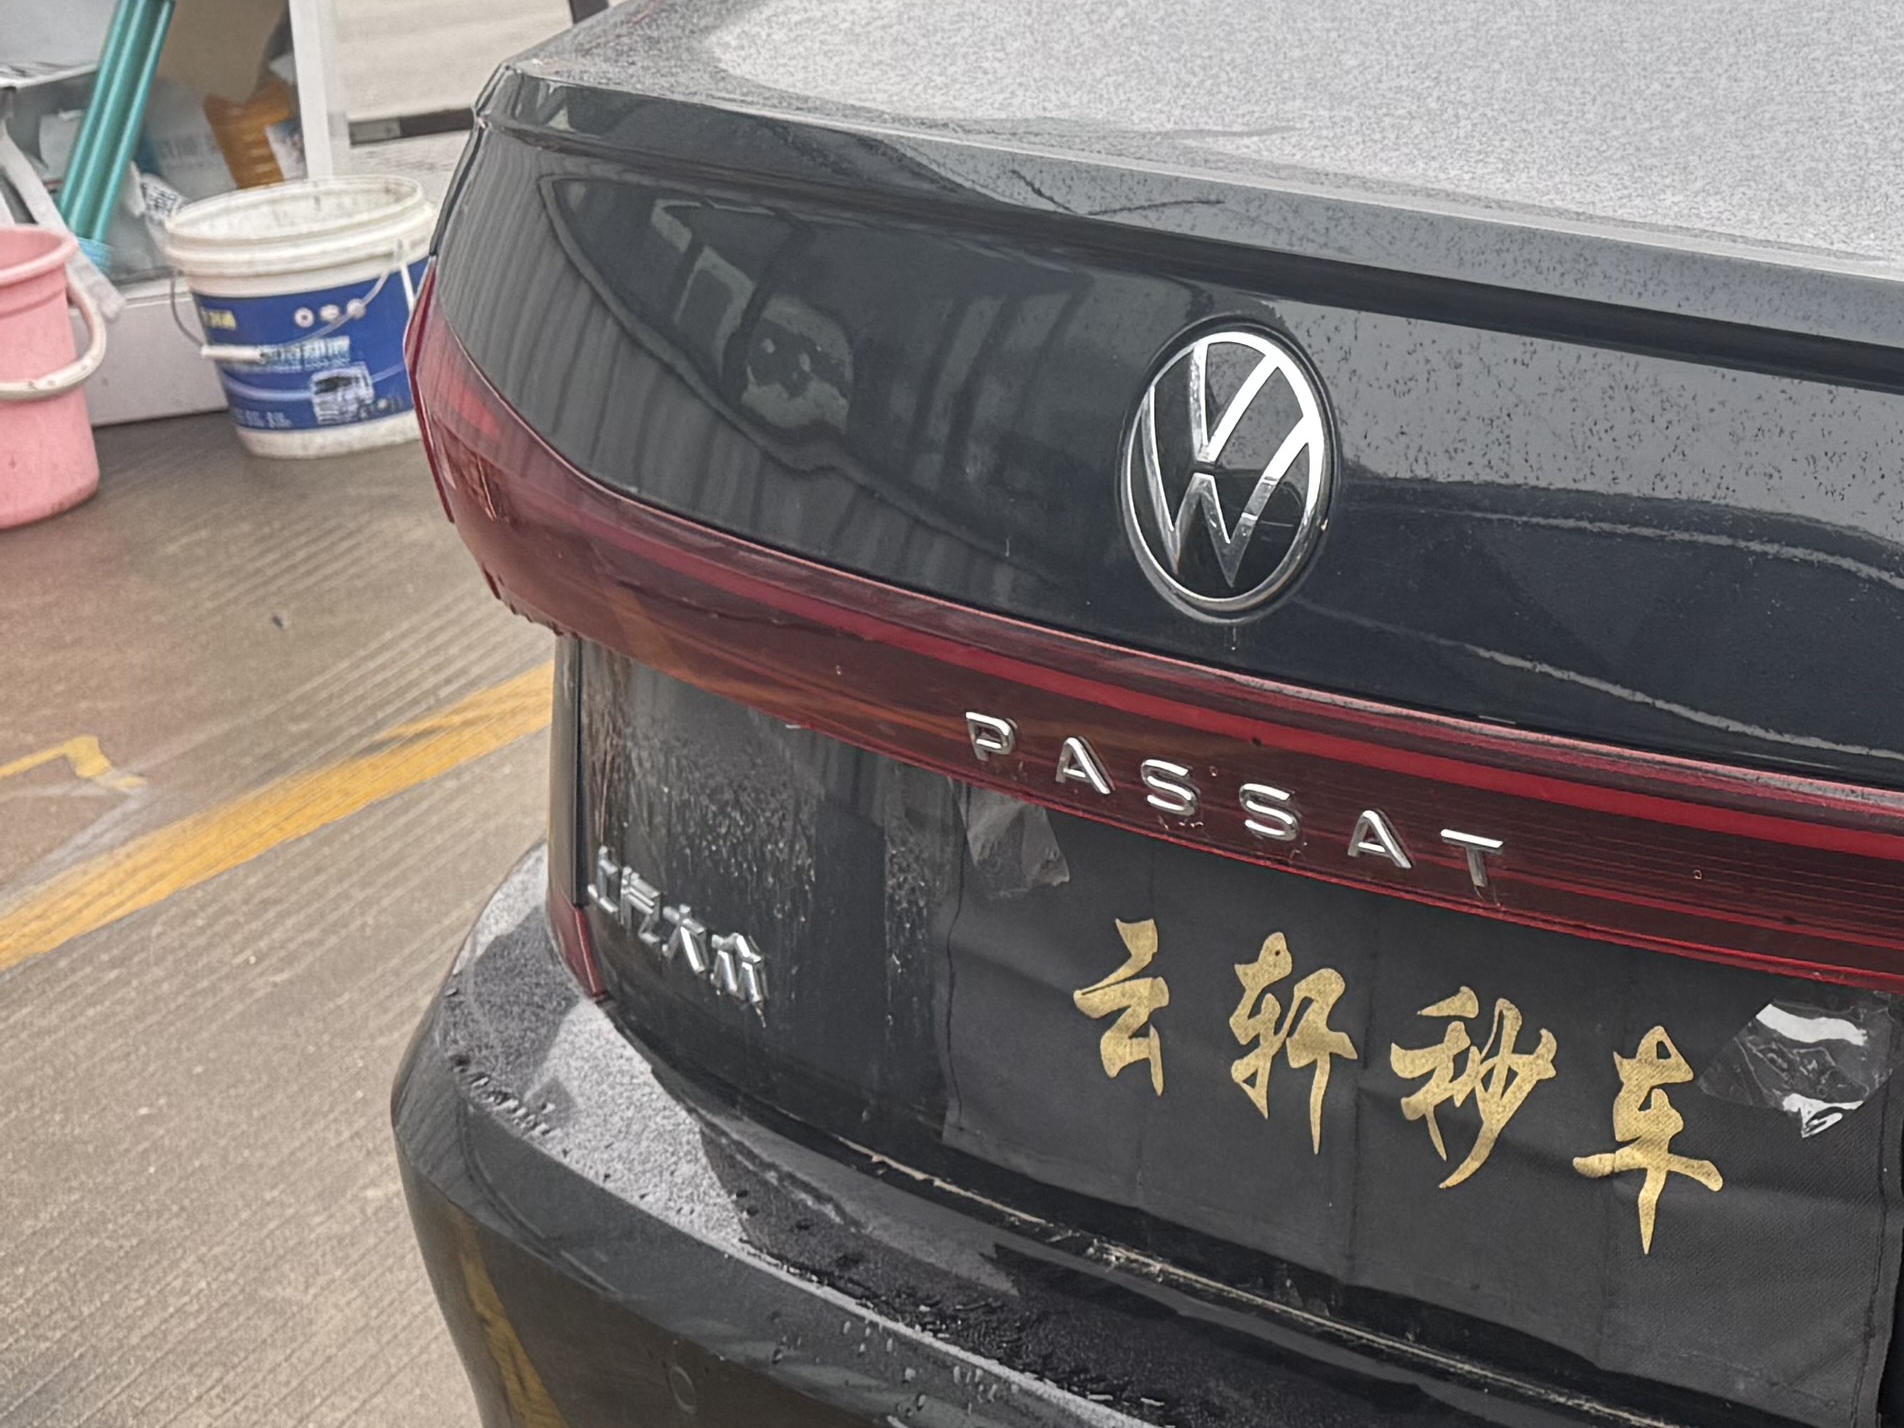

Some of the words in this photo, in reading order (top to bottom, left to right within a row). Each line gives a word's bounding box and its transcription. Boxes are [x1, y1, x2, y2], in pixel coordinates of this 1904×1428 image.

[965, 710, 1505, 888] PASSAT
[587, 845, 766, 1004] 上汽大众
